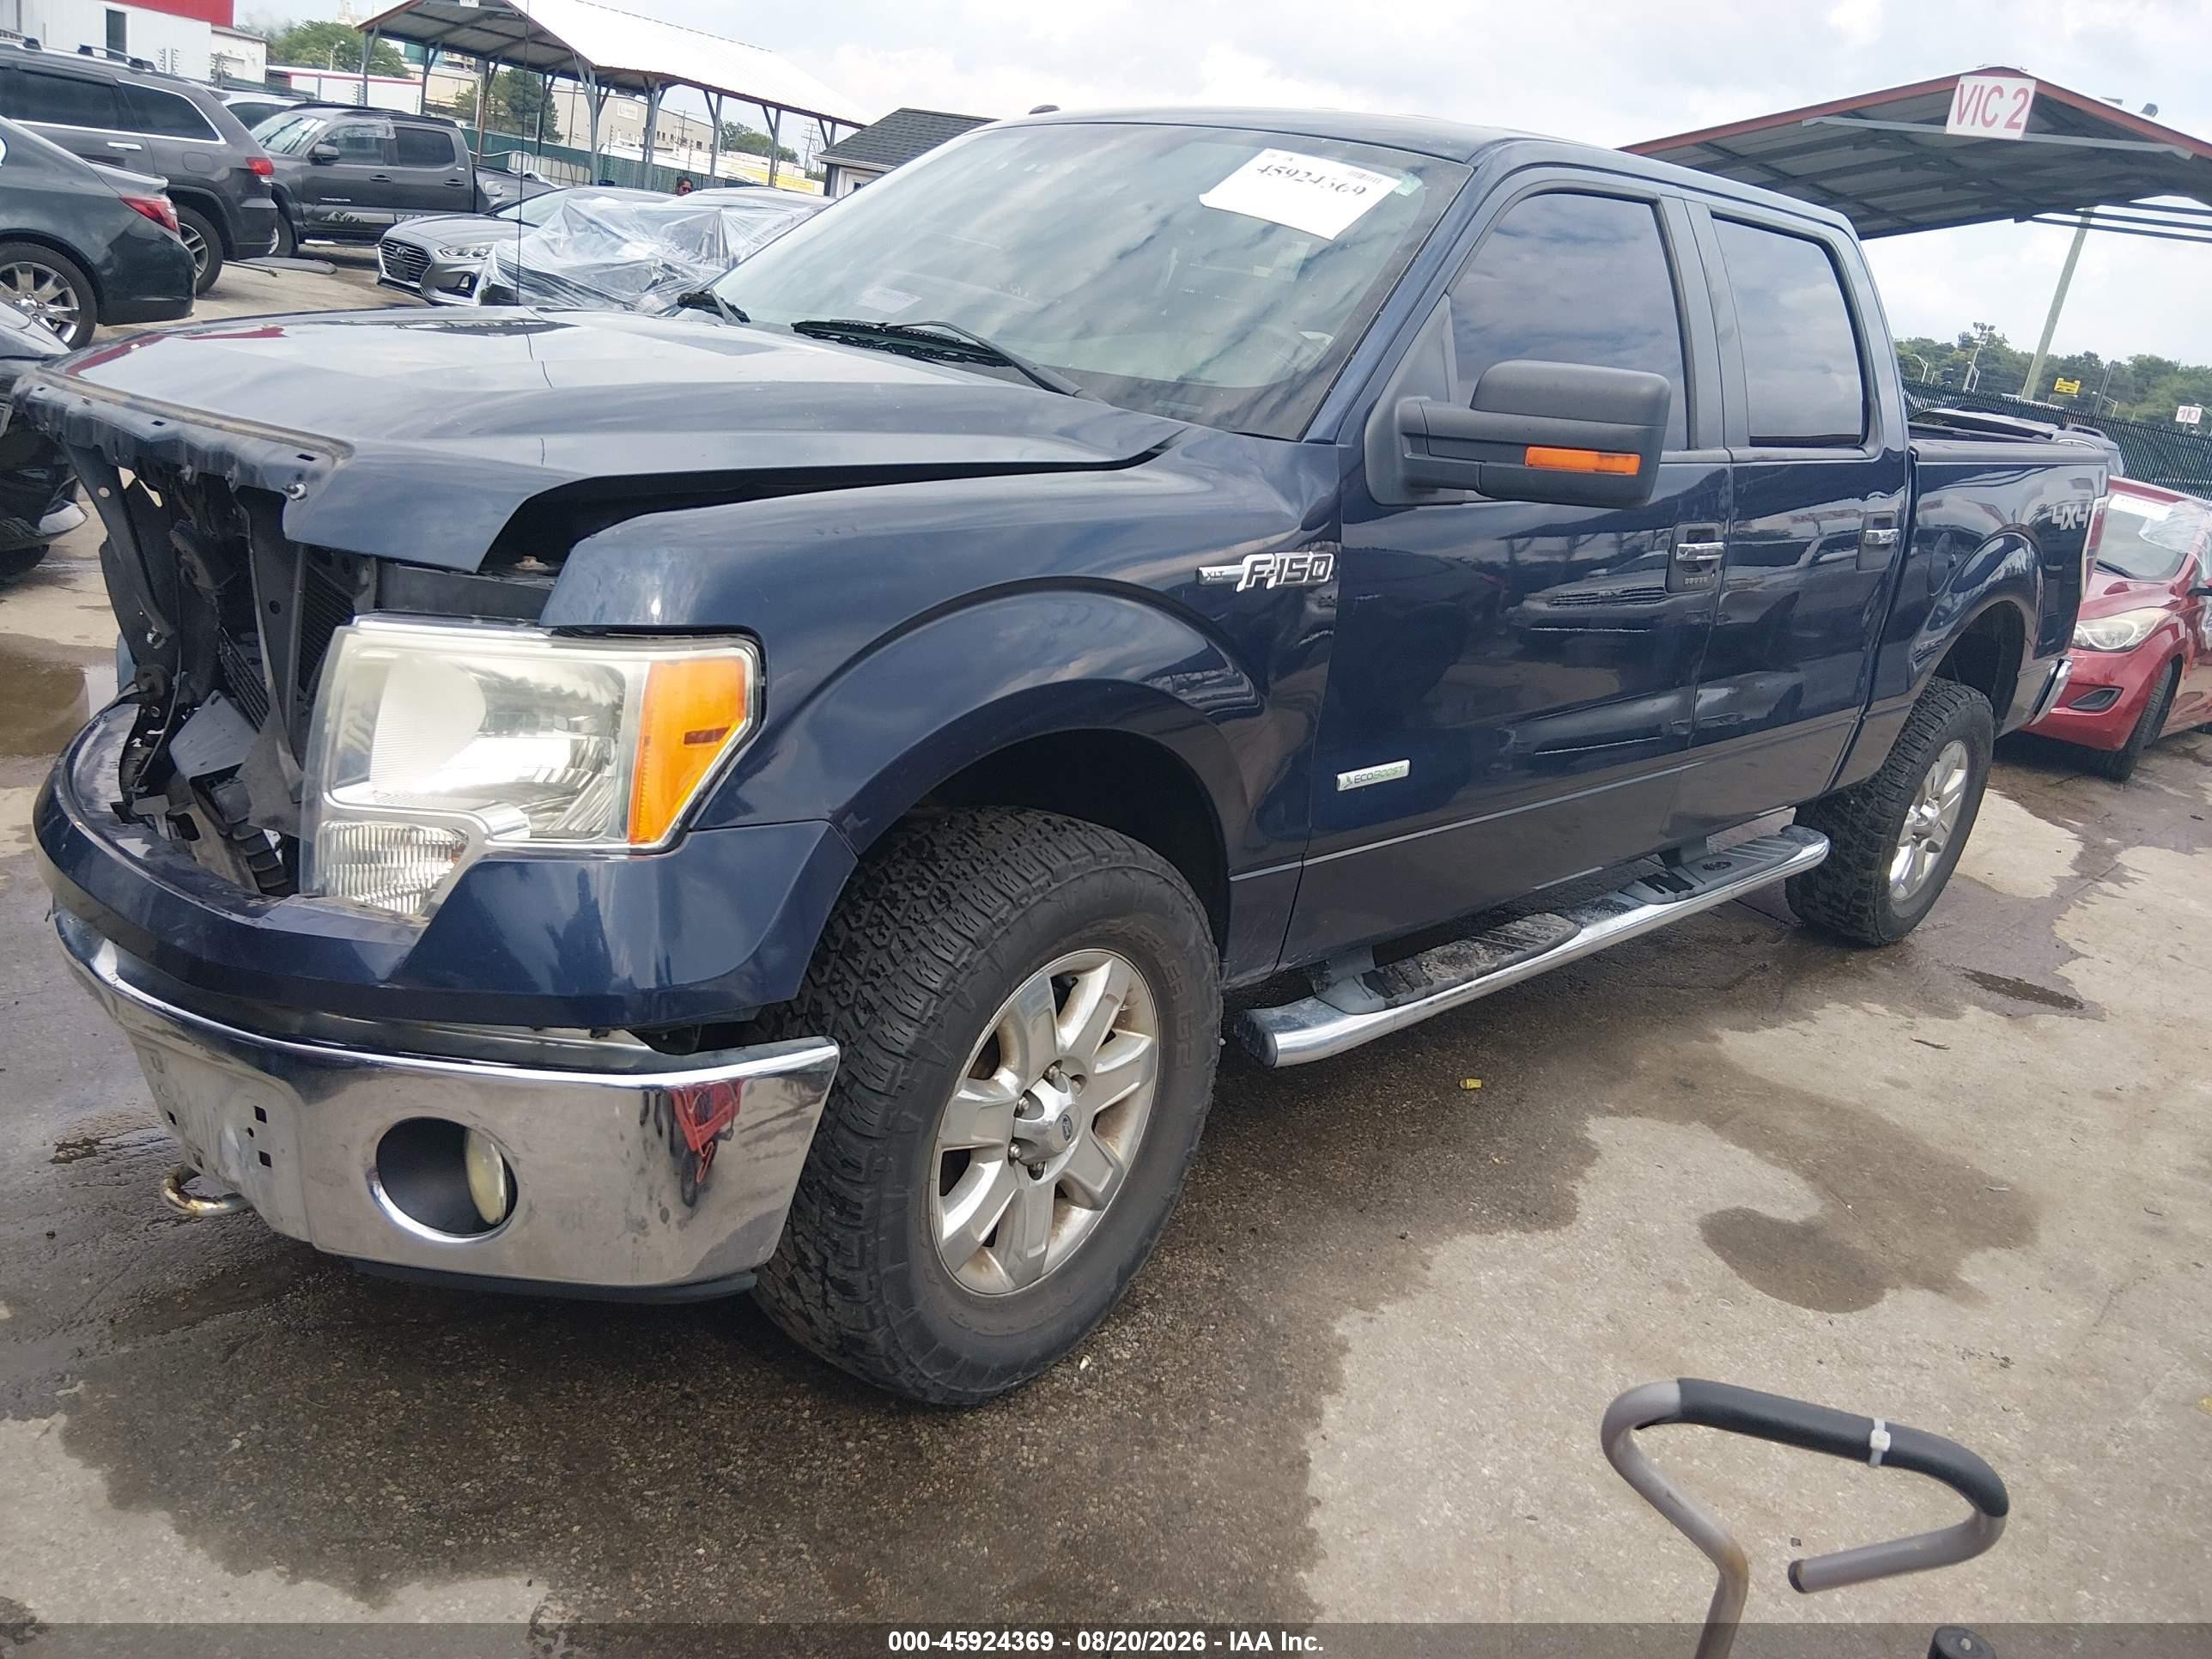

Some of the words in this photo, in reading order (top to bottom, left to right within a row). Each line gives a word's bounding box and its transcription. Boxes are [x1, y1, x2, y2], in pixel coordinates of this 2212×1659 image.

[1956, 83, 2004, 128] VIC
[2003, 88, 2030, 130] 2
[1237, 552, 1334, 592] F-150
